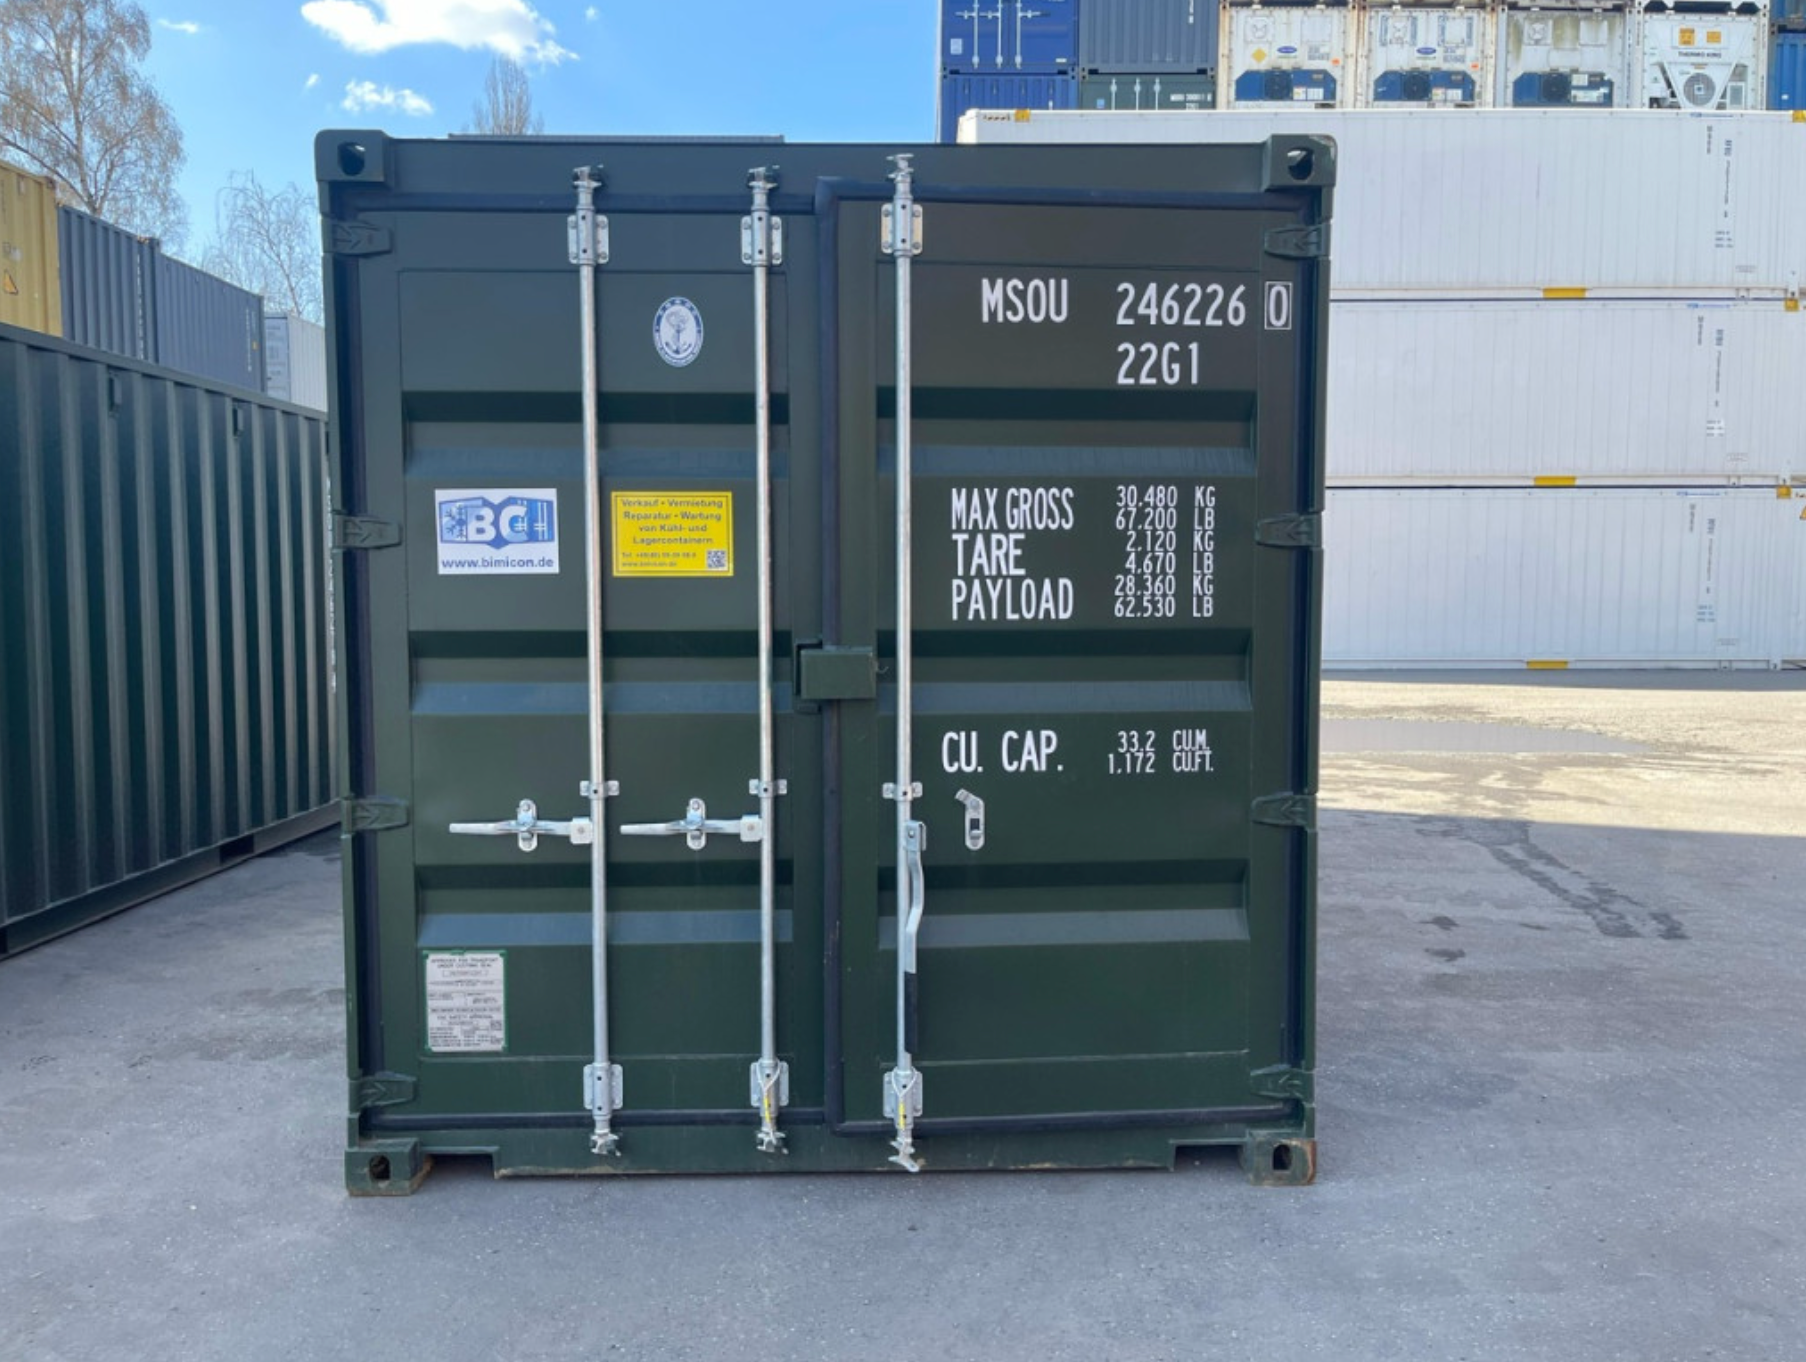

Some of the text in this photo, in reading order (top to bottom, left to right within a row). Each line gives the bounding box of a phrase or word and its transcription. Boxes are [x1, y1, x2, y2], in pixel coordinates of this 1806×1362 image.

[982, 278, 1068, 323] MSOU
[1116, 283, 1246, 327] 246226
[1117, 342, 1199, 385] 22G1
[621, 499, 723, 508] Verkauf Vermietung
[1116, 485, 1216, 507] 30.480 KG
[623, 511, 722, 522] Reparatur Wartung
[951, 487, 1074, 530] MAX GROSS
[1115, 507, 1215, 530] 67.200 LB
[688, 524, 708, 532] und
[632, 536, 714, 545] Lagercontainern
[1125, 530, 1214, 552] 2.120 KG
[441, 556, 554, 569] www.bimicon.de
[951, 533, 1026, 577] TARE
[1125, 552, 1214, 574] 4.670 LB
[1114, 574, 1214, 596] 28.360 KG
[951, 578, 1074, 621] PAYLOAD
[1114, 596, 1214, 618] 62.530 LB
[941, 730, 1064, 773] CU. CAP.
[1117, 730, 1156, 752] 33.2
[1107, 752, 1156, 774] 1.172
